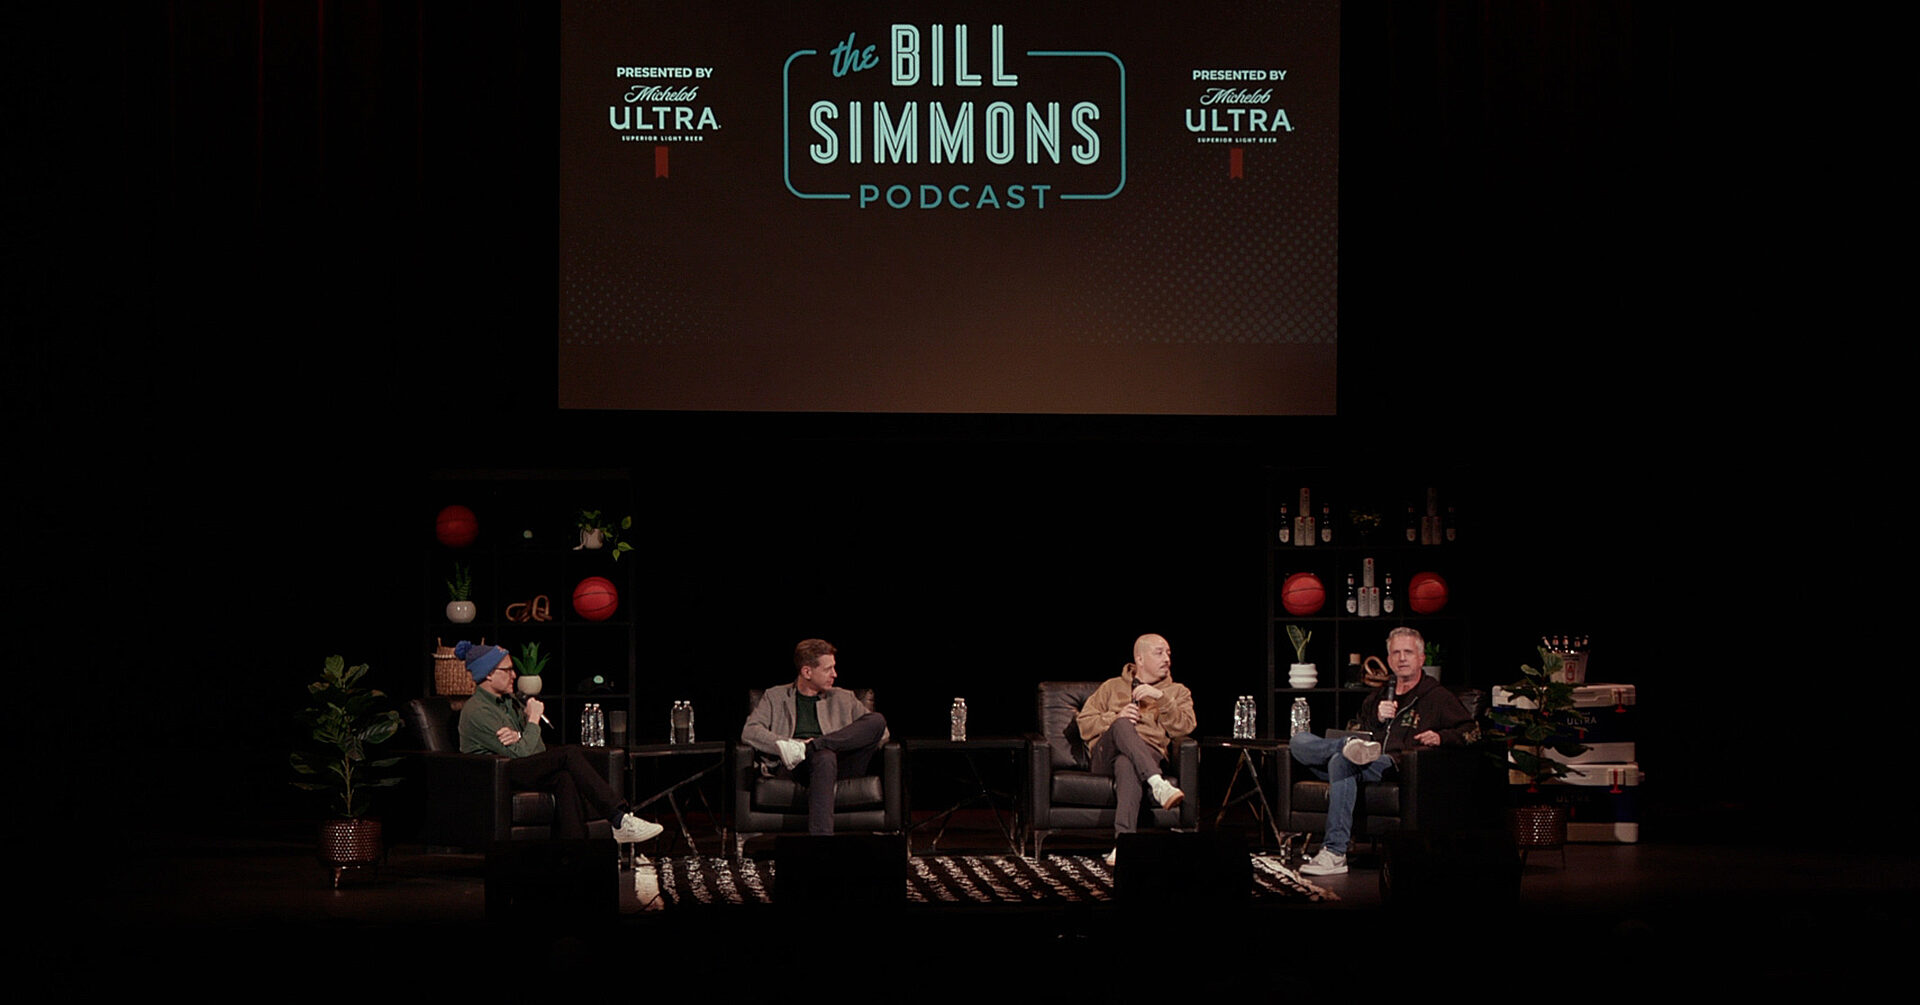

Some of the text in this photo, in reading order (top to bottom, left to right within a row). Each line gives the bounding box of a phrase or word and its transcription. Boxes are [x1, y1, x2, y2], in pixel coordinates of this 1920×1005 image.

[829, 23, 1018, 87] the BILL
[616, 66, 714, 78] PRESENTED BY
[1192, 69, 1287, 80] PRESENTED BY
[623, 84, 700, 103] Michelob
[1199, 87, 1274, 105] Michelob
[809, 100, 1100, 165] SIMMONS
[859, 184, 1051, 209] PODCAST
